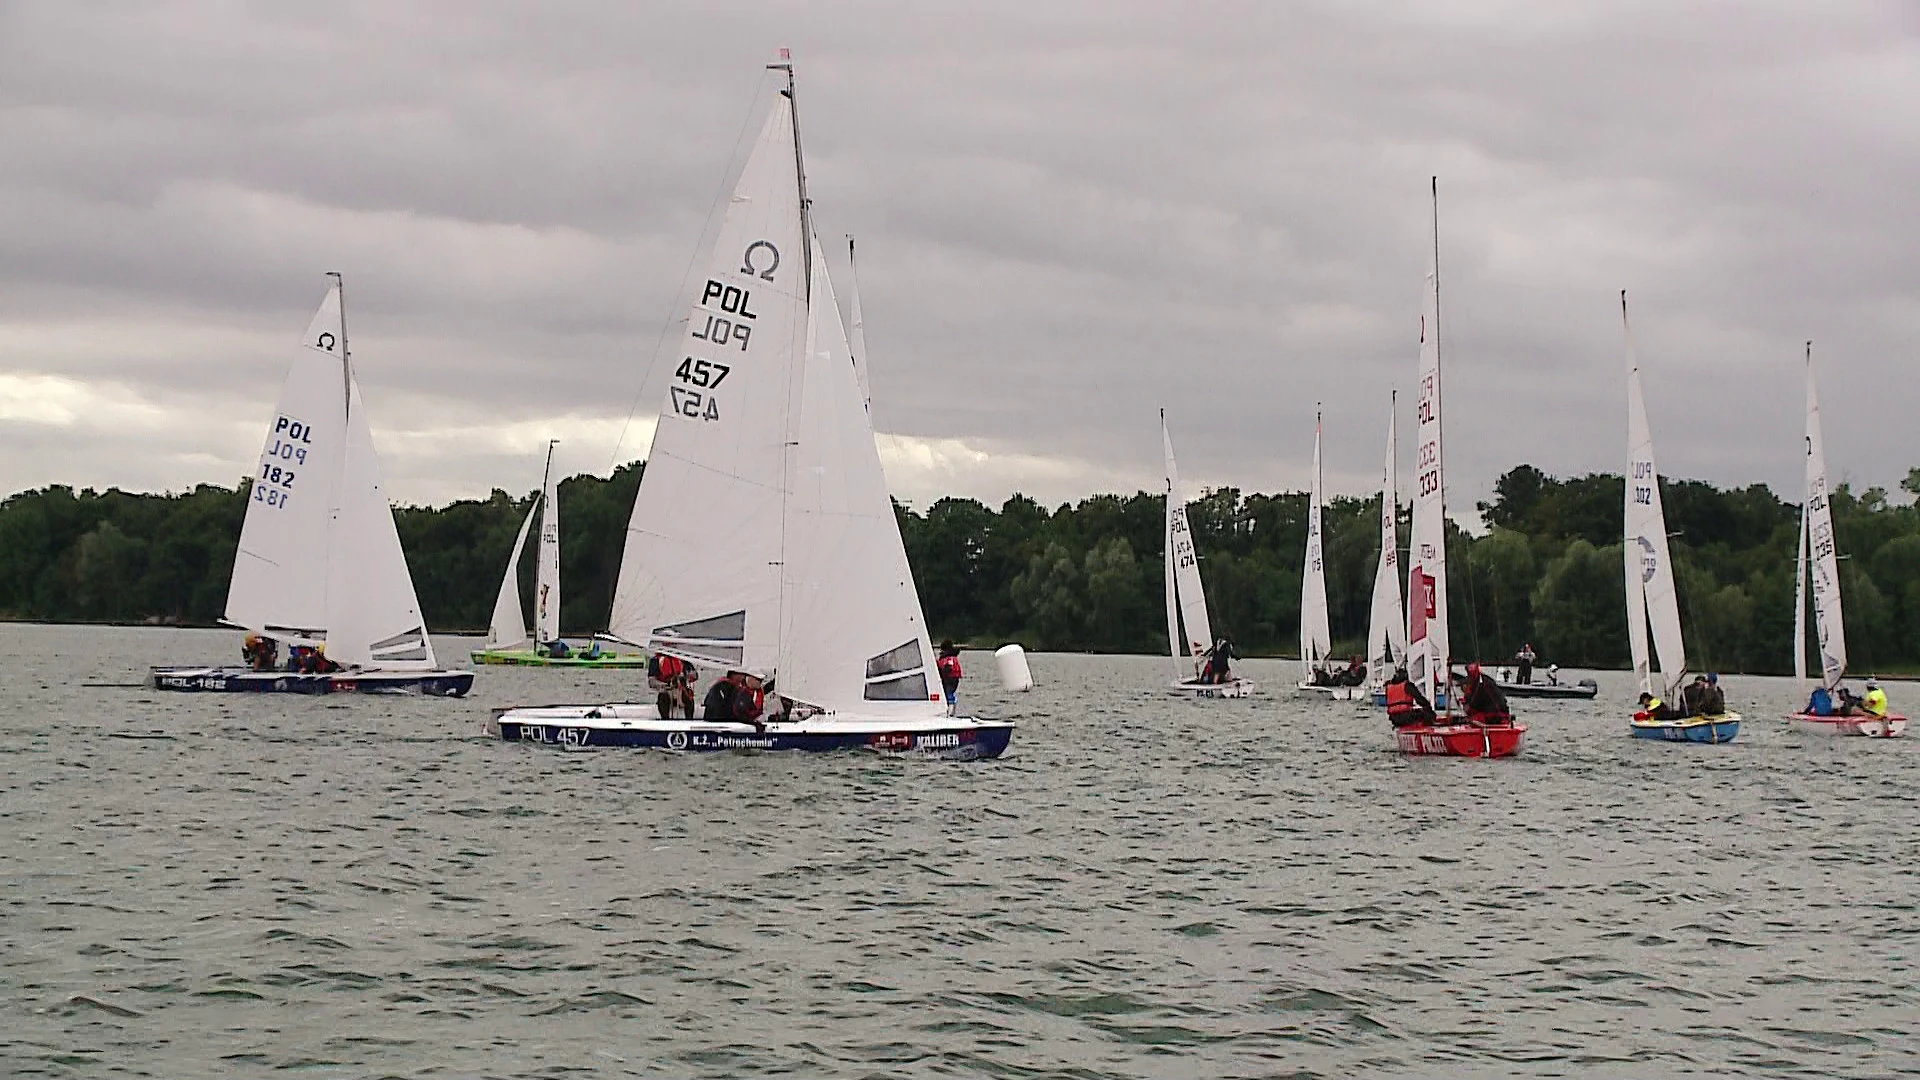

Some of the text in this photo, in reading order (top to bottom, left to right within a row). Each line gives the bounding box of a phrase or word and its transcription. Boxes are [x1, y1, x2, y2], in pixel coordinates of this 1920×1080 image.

[701, 279, 757, 319] POL
[675, 356, 730, 389] 457
[275, 416, 312, 443] POL
[262, 463, 294, 488] 182
[1419, 470, 1438, 497] 333
[519, 725, 590, 746] POL 457
